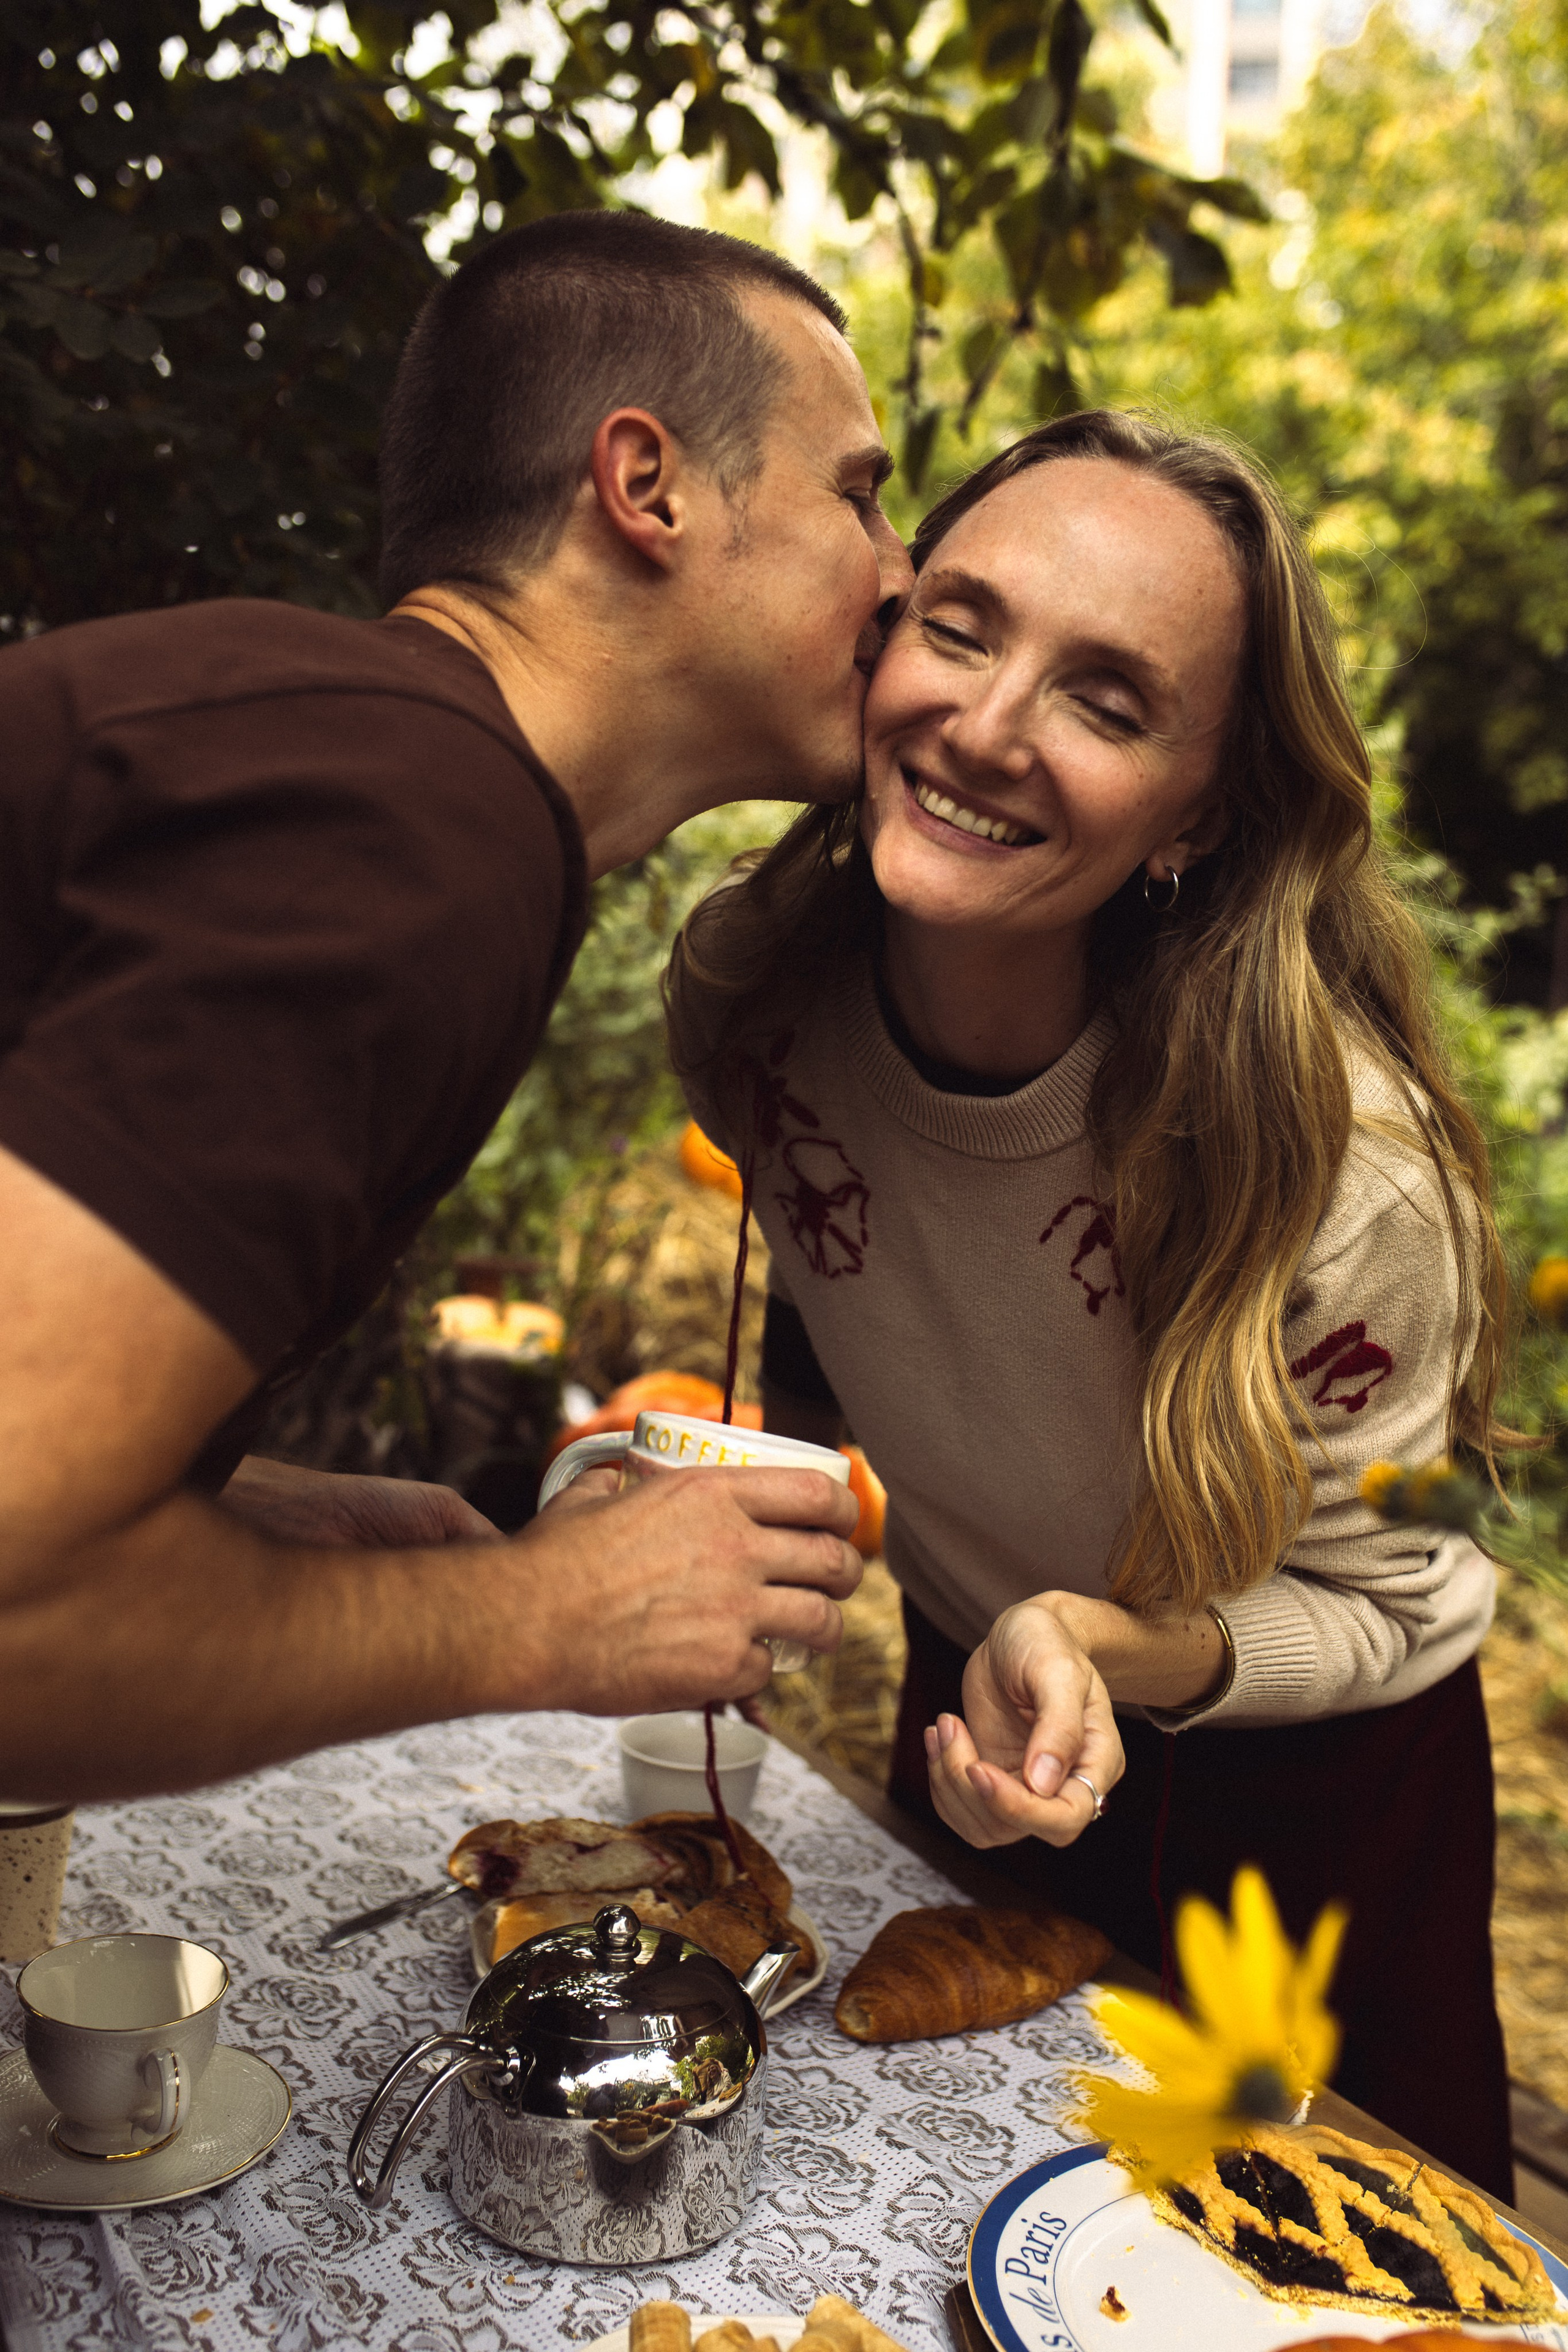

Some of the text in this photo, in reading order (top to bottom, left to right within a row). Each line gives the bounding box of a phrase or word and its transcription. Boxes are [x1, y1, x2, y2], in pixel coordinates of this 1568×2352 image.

[646, 1424, 757, 1467] COFFEE
[1005, 2211, 1067, 2286] Paris
[1009, 2287, 1060, 2324] de
